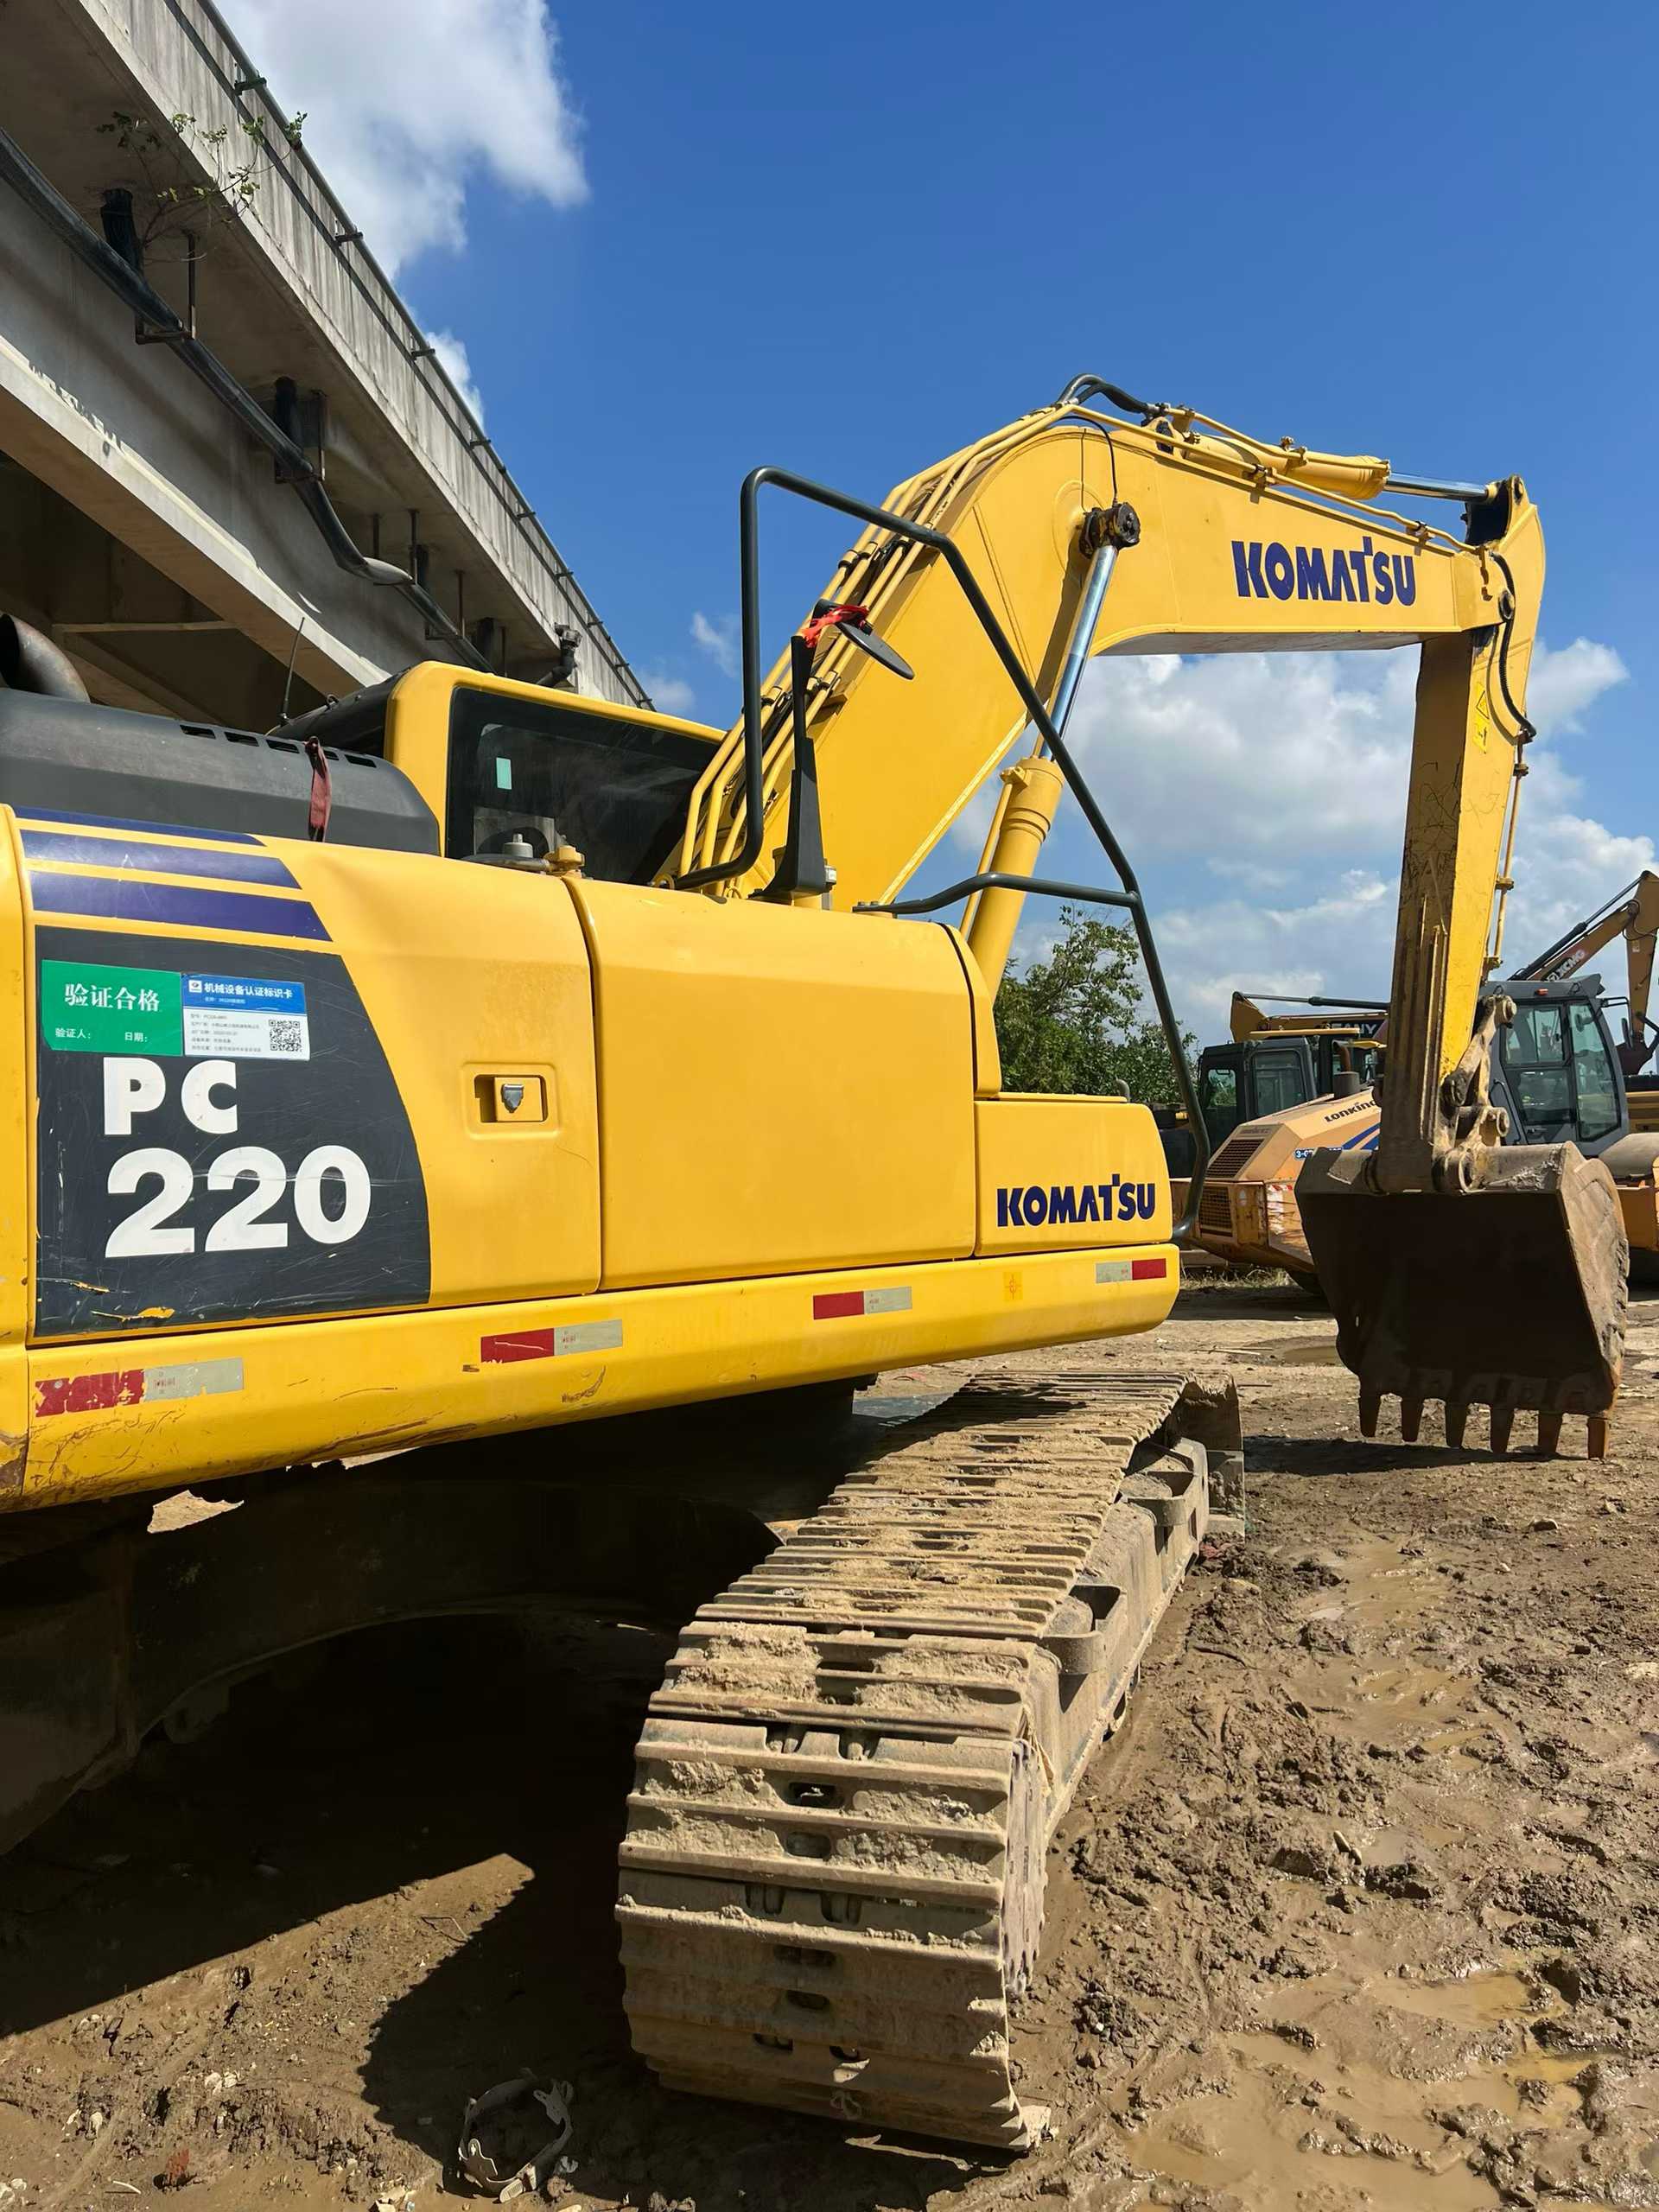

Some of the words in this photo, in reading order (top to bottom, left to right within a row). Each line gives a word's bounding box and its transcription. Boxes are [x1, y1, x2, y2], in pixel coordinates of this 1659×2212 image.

[1231, 536, 1415, 606] KOMATSU
[64, 983, 160, 1012] 验证合格
[204, 982, 293, 999] 机械设备认证标识卡
[104, 1057, 238, 1135] PC
[105, 1145, 372, 1258] 220
[997, 1173, 1155, 1227] KOMATSU
